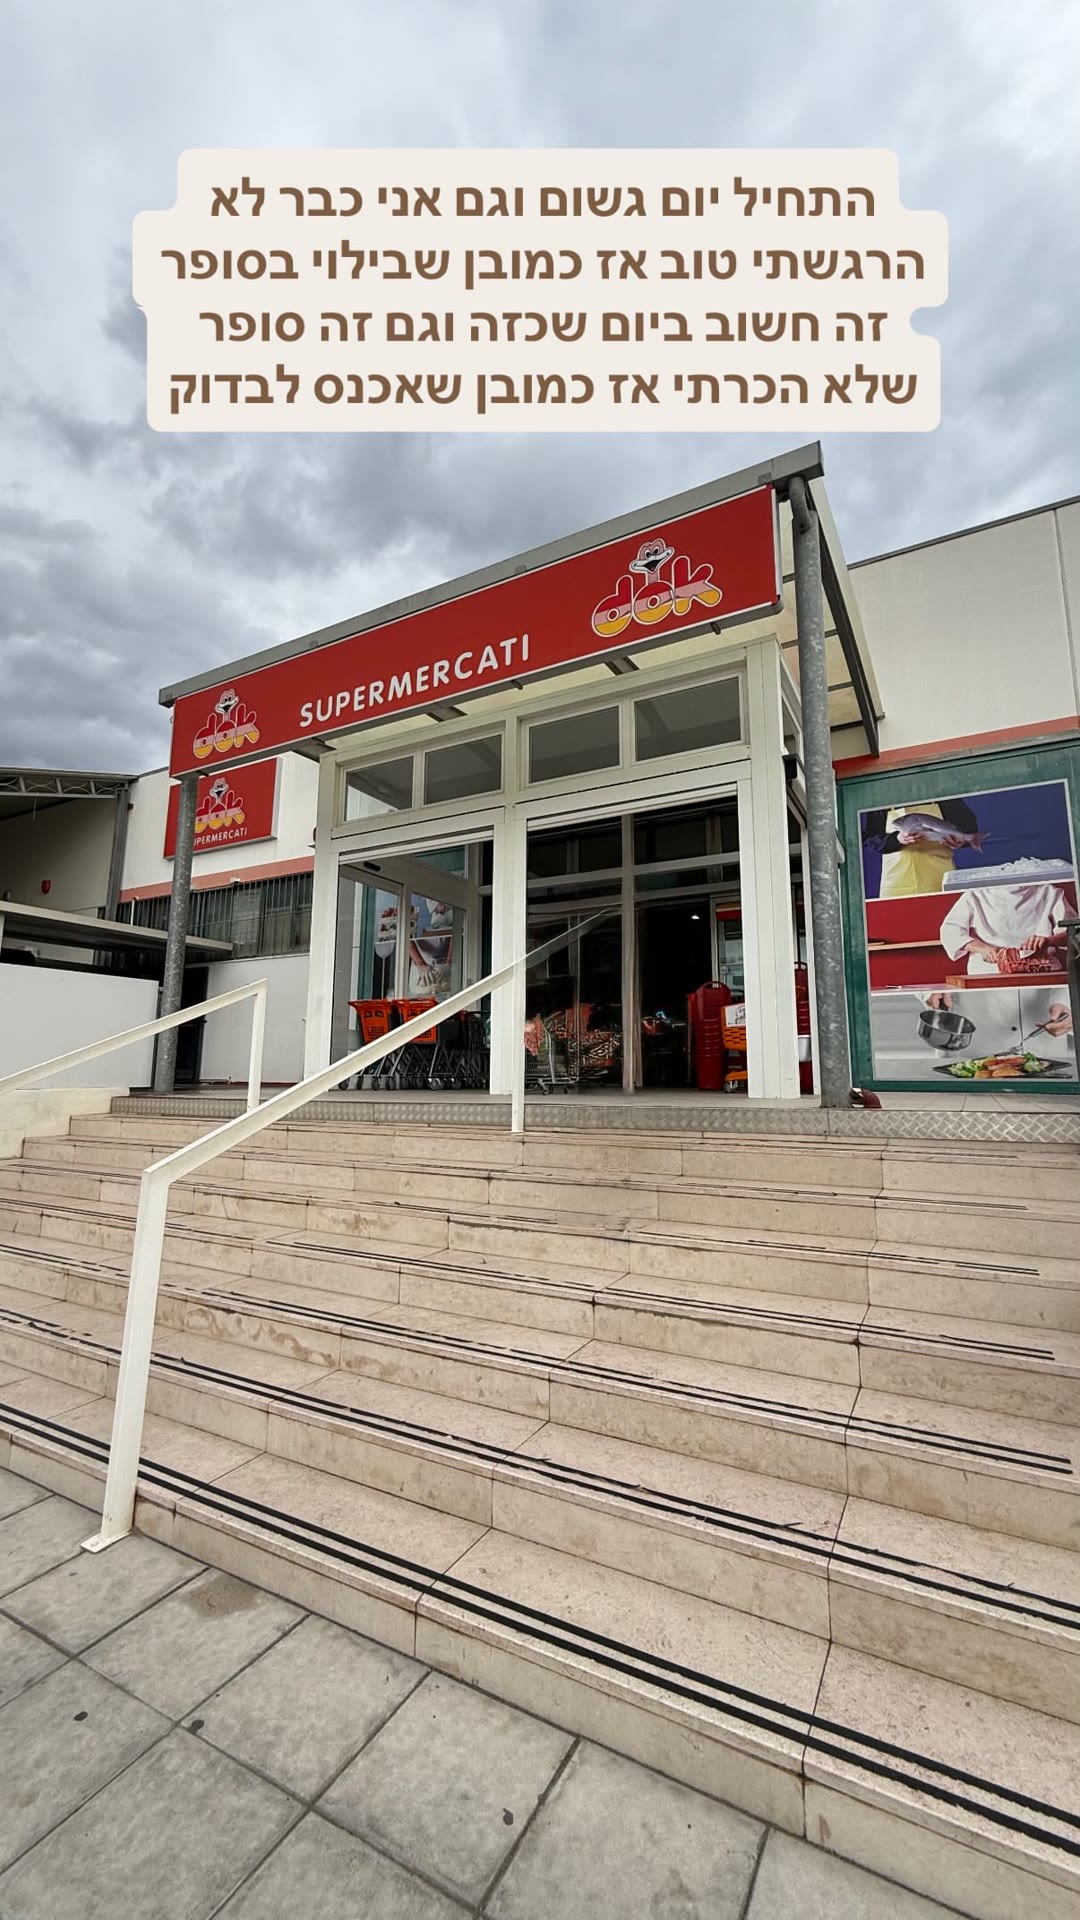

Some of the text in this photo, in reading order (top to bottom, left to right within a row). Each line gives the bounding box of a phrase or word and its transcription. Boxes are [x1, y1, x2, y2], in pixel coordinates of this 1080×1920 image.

[591, 554, 723, 638] dok
[300, 633, 529, 728] SUPERMERCATI
[193, 827, 248, 847] PERMERCATI
